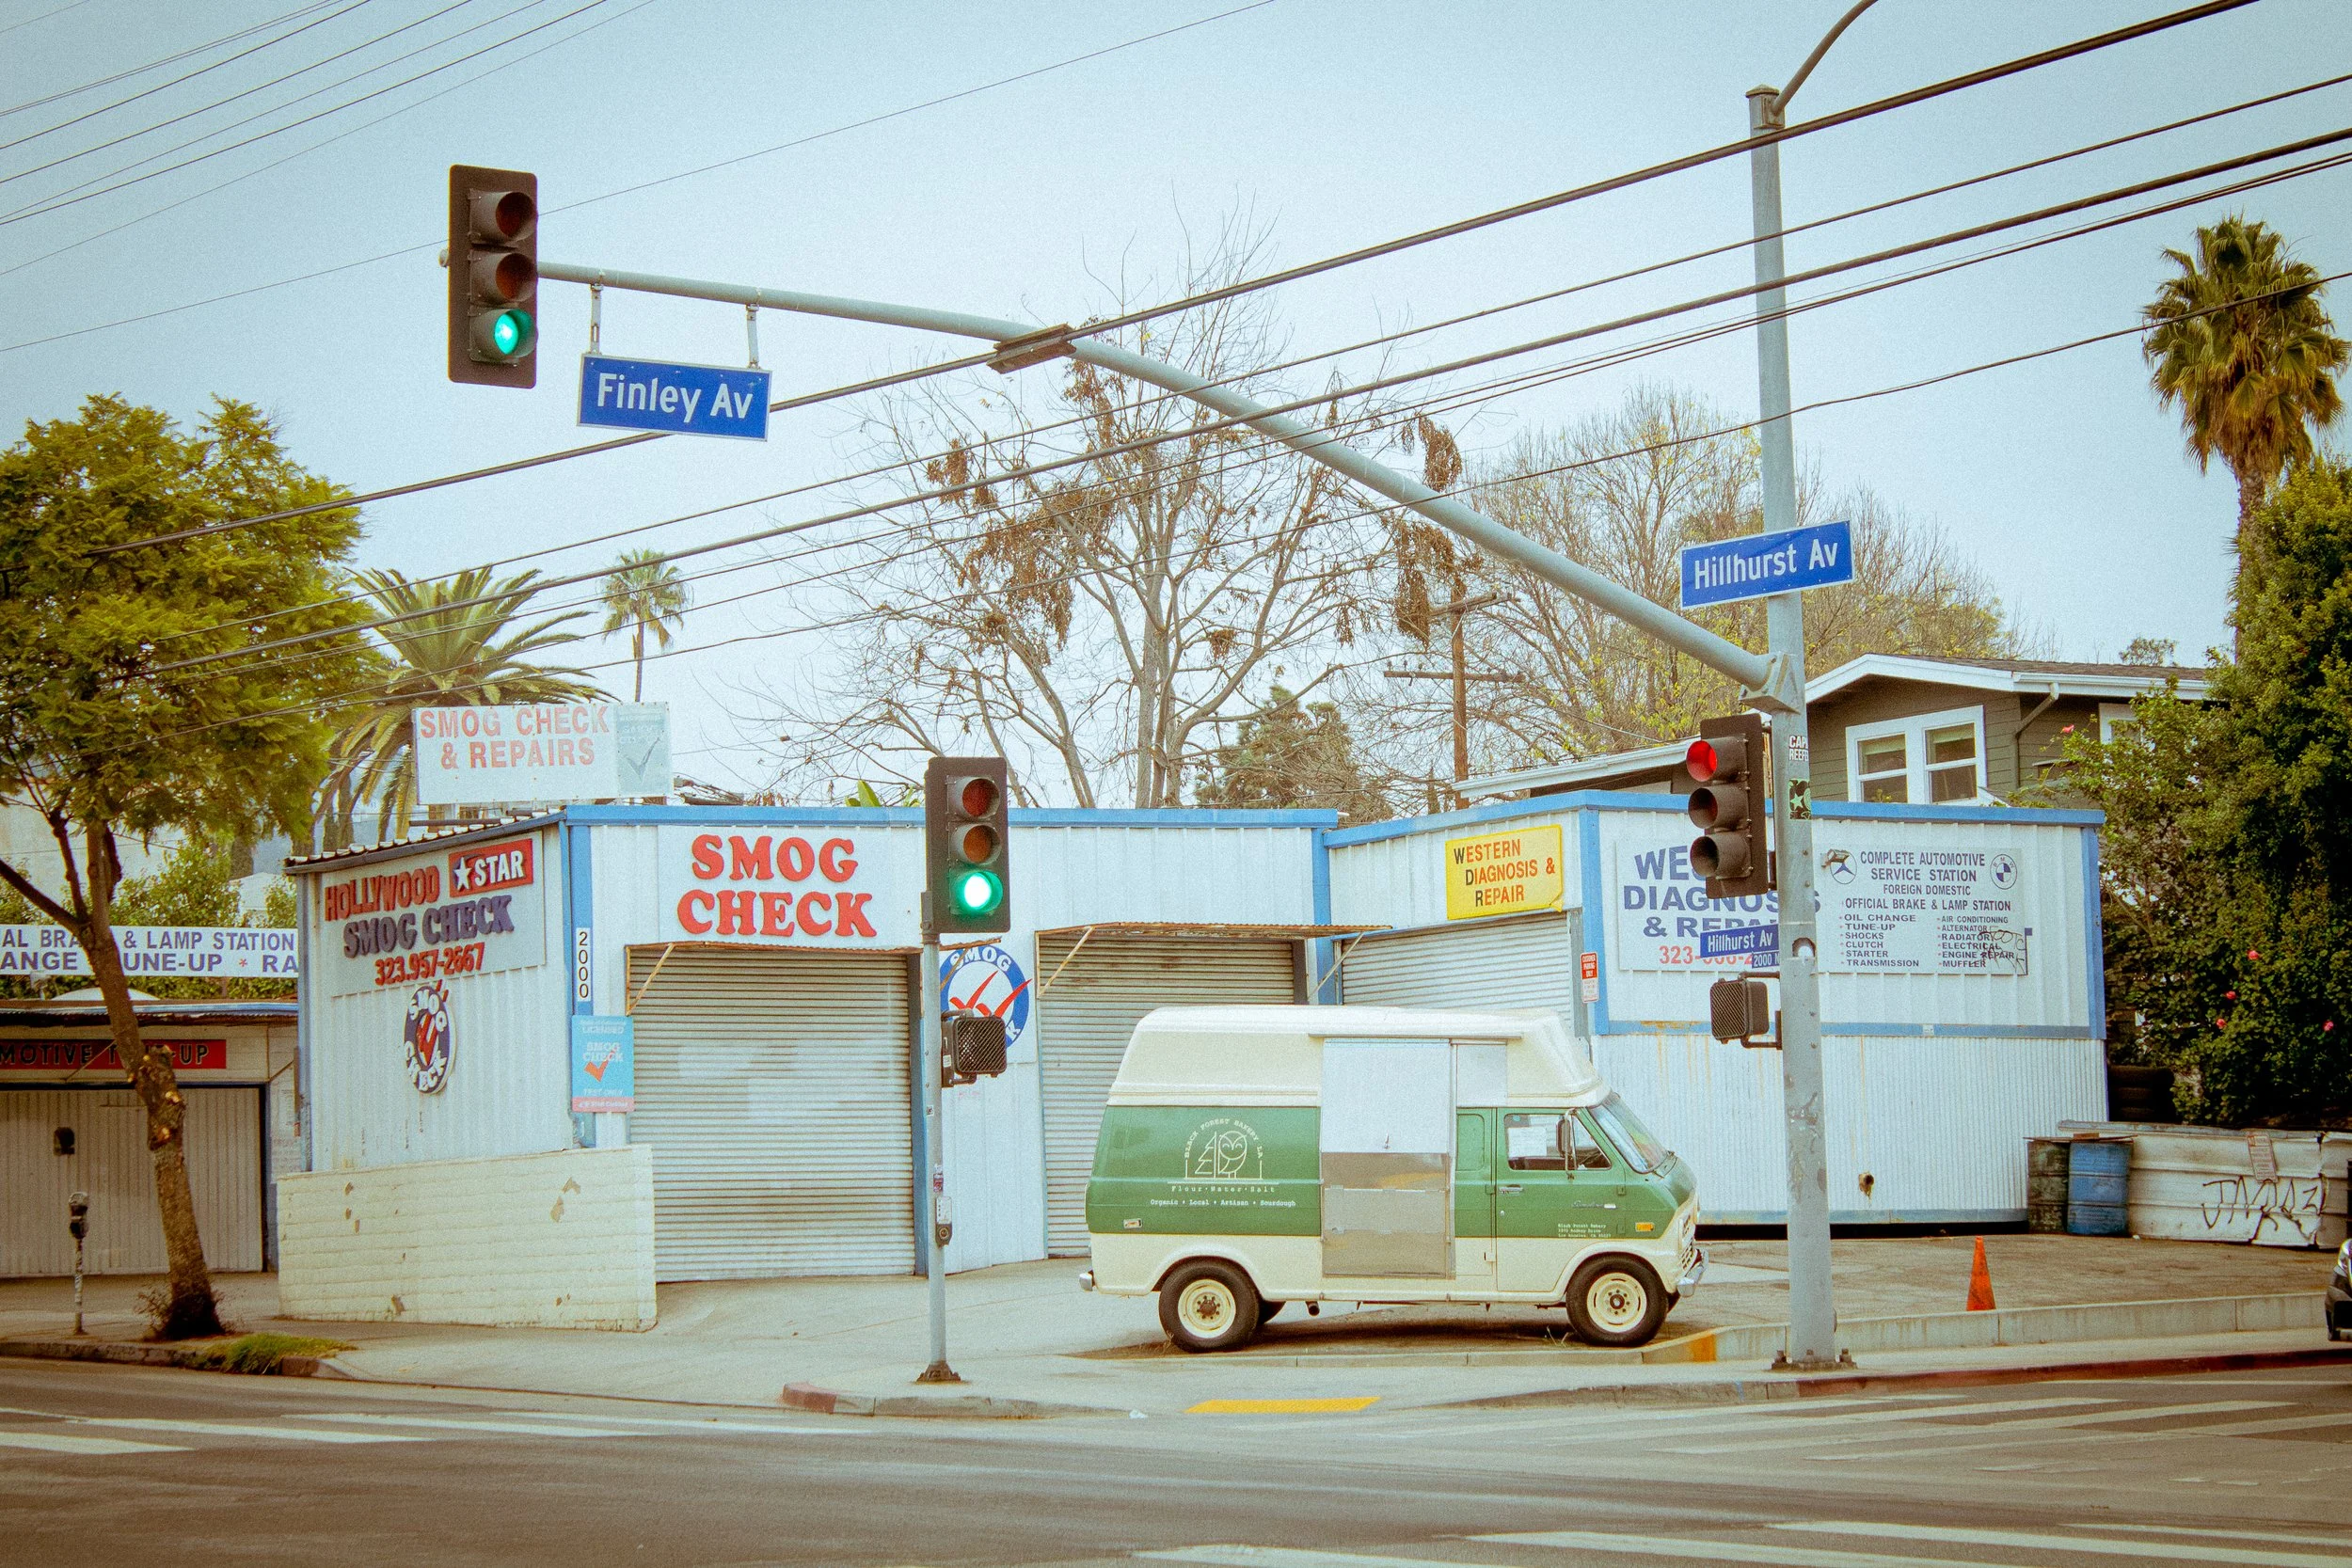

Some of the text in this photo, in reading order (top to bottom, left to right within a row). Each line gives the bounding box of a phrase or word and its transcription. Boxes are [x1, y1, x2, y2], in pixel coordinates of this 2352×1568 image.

[596, 372, 753, 423] Finley Av
[1694, 538, 1837, 590] Hillhurst Av
[421, 709, 501, 738] SMOG
[516, 705, 610, 736] CHECK
[440, 737, 595, 769] & REPAIRS
[691, 833, 859, 882] SMOG
[1454, 838, 1520, 864] WESTERN
[1860, 850, 1985, 866] COMPLETE AUTOMOTIVE
[1465, 857, 1555, 886] DIAGNOSIS &
[1871, 867, 1977, 882] SERVICE STATION
[325, 850, 525, 922] HOLLYWOOD STAR
[1475, 884, 1524, 907] REPAIR
[1883, 884, 1971, 895] FOREIGN DOMESTIC
[676, 889, 877, 938] CHECK
[1845, 897, 2011, 911] OFFICIAL BRAKE & LAMP STATION
[343, 895, 515, 958] SMOG CHECK
[1644, 916, 1667, 938] &
[1845, 923, 1896, 931] TUNE-UP
[1956, 915, 2009, 924] CONDITIONING
[123, 930, 136, 948] &
[147, 930, 202, 949] LAMP
[214, 931, 294, 951] STATION
[1708, 929, 1773, 953] Hillhurst Av
[123, 952, 222, 972] UNE-UP
[578, 930, 589, 999] 2000
[950, 945, 1010, 973] SMOG
[1754, 953, 1772, 967] 2000
[1980, 951, 2014, 959] REPAIR
[408, 989, 448, 1032] SMOG
[404, 1040, 448, 1091] CHECK
[1150, 1198, 1179, 1207] Organic
